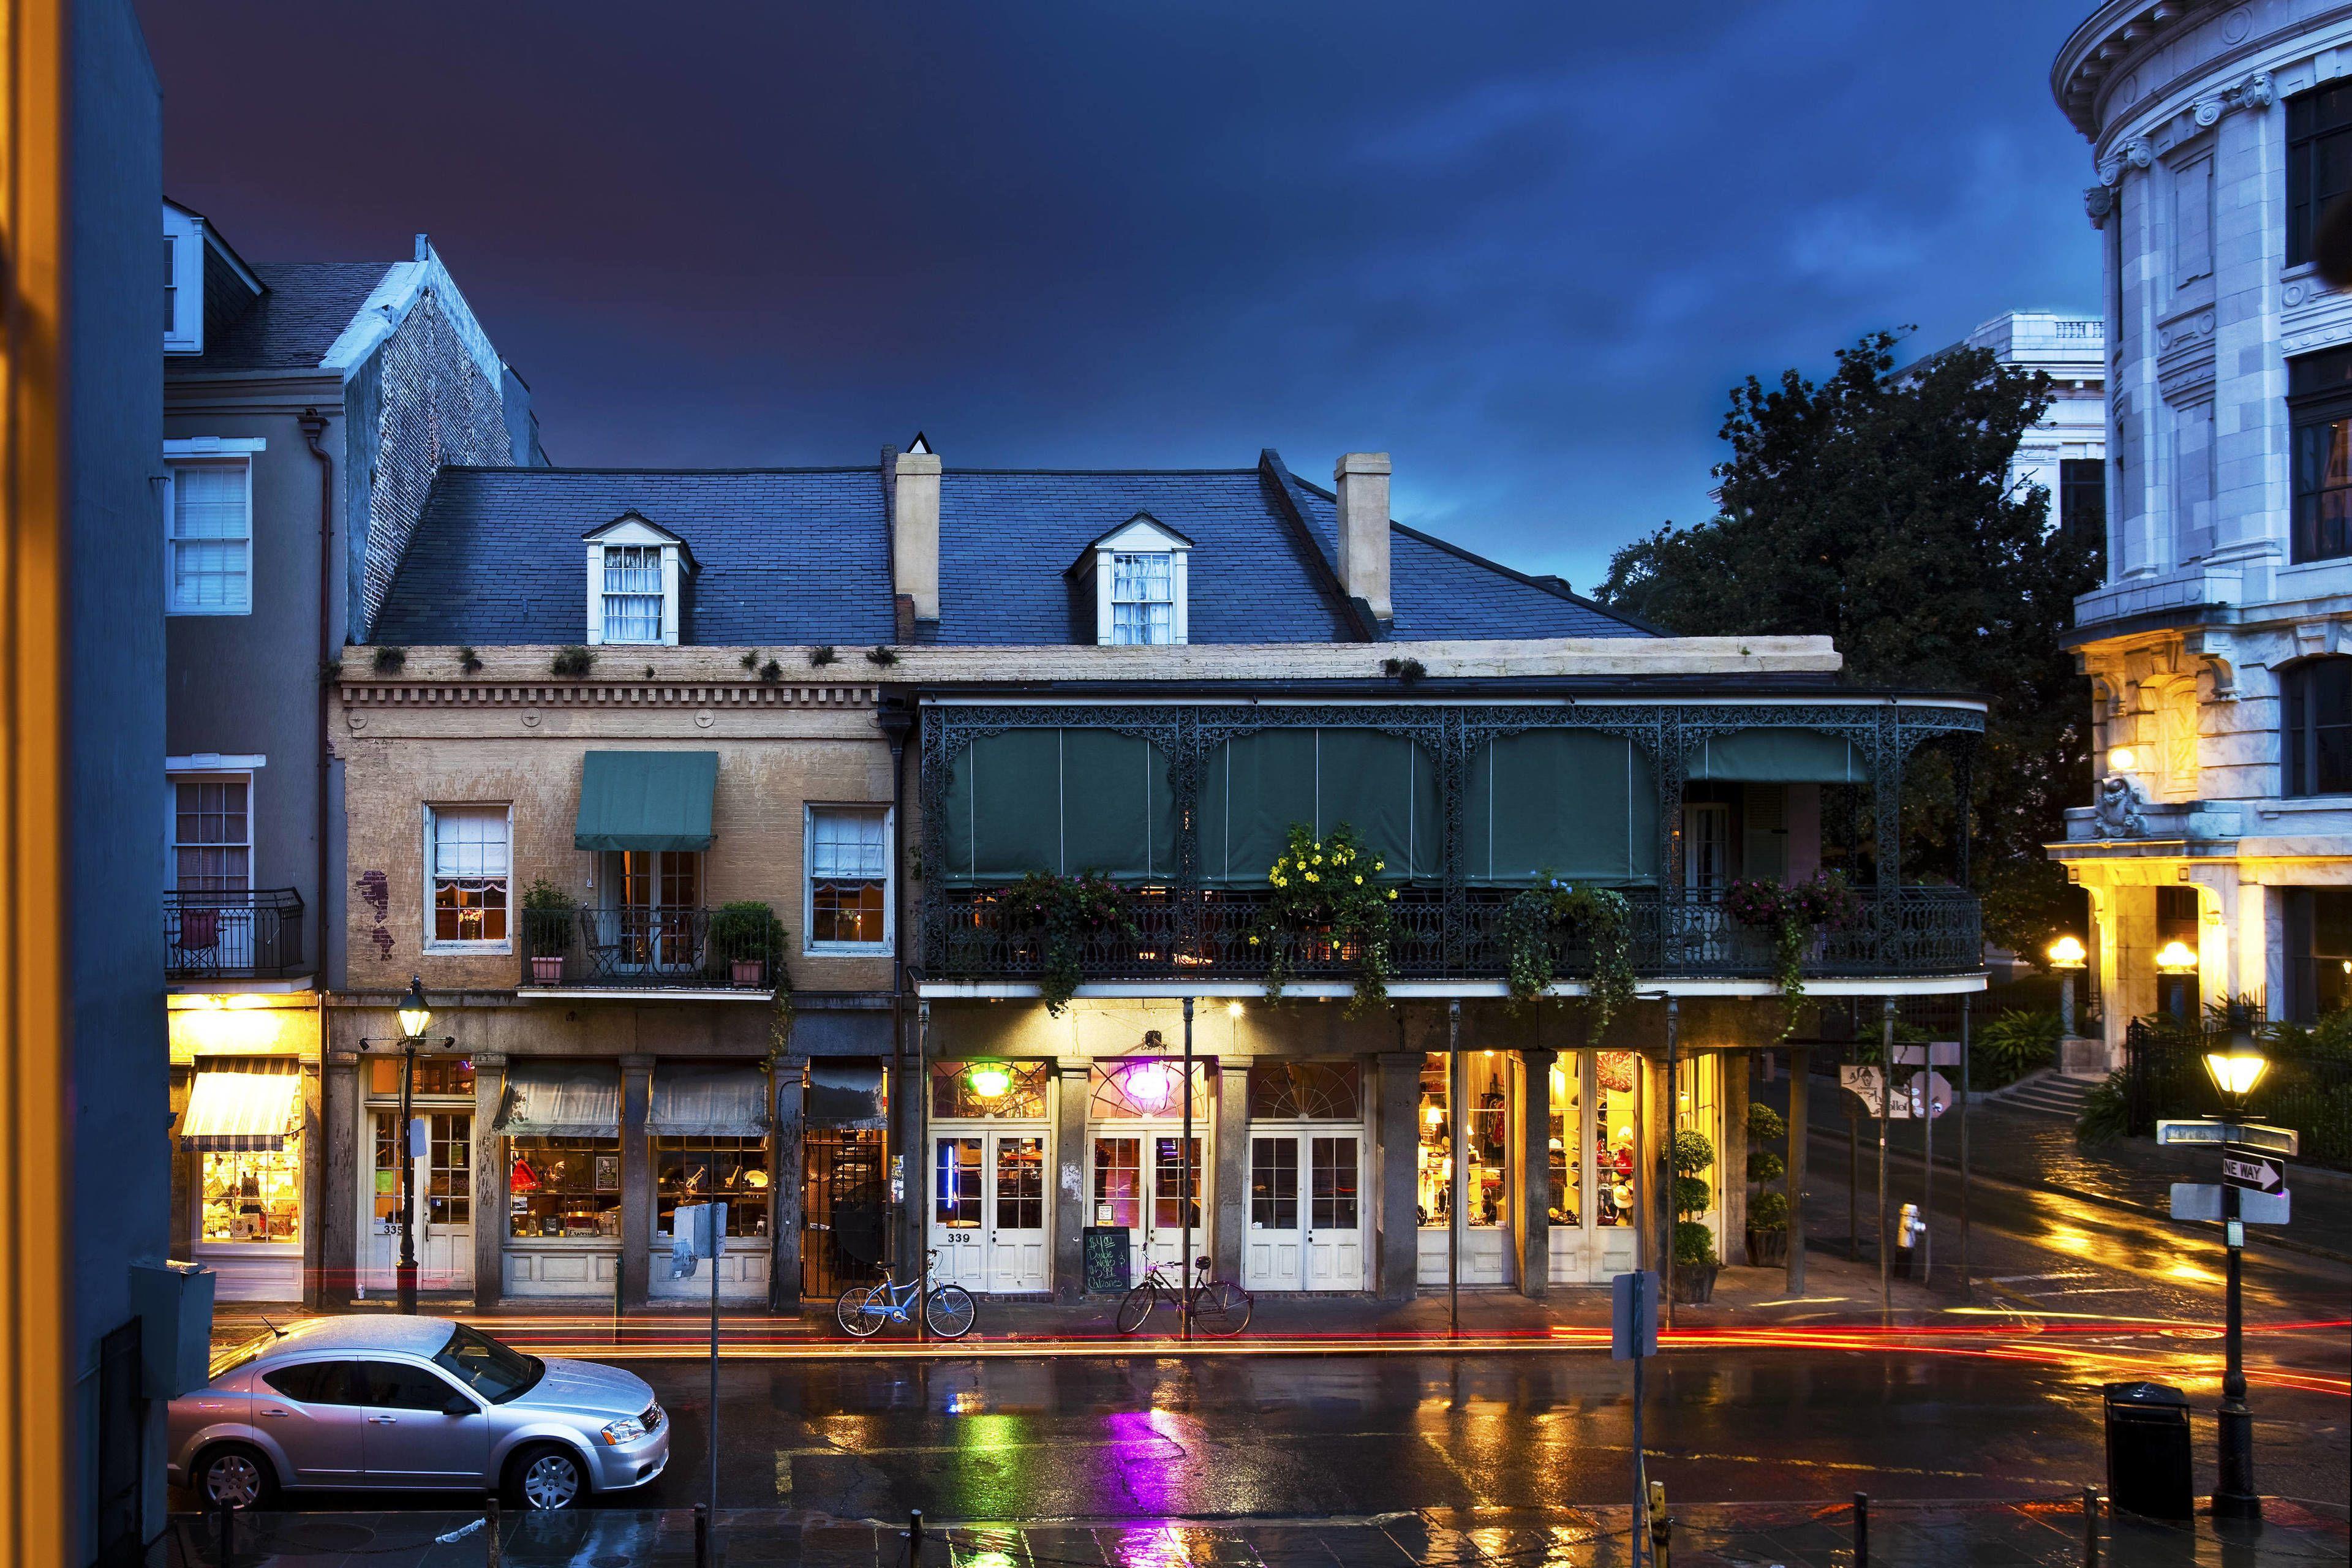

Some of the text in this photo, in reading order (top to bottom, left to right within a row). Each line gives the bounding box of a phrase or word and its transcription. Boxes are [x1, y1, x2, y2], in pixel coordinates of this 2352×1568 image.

[2224, 1159, 2261, 1180] NE WAY
[384, 1226, 402, 1234] 335
[948, 1234, 970, 1242] 339
[1088, 1277, 1123, 1289] Calzones
